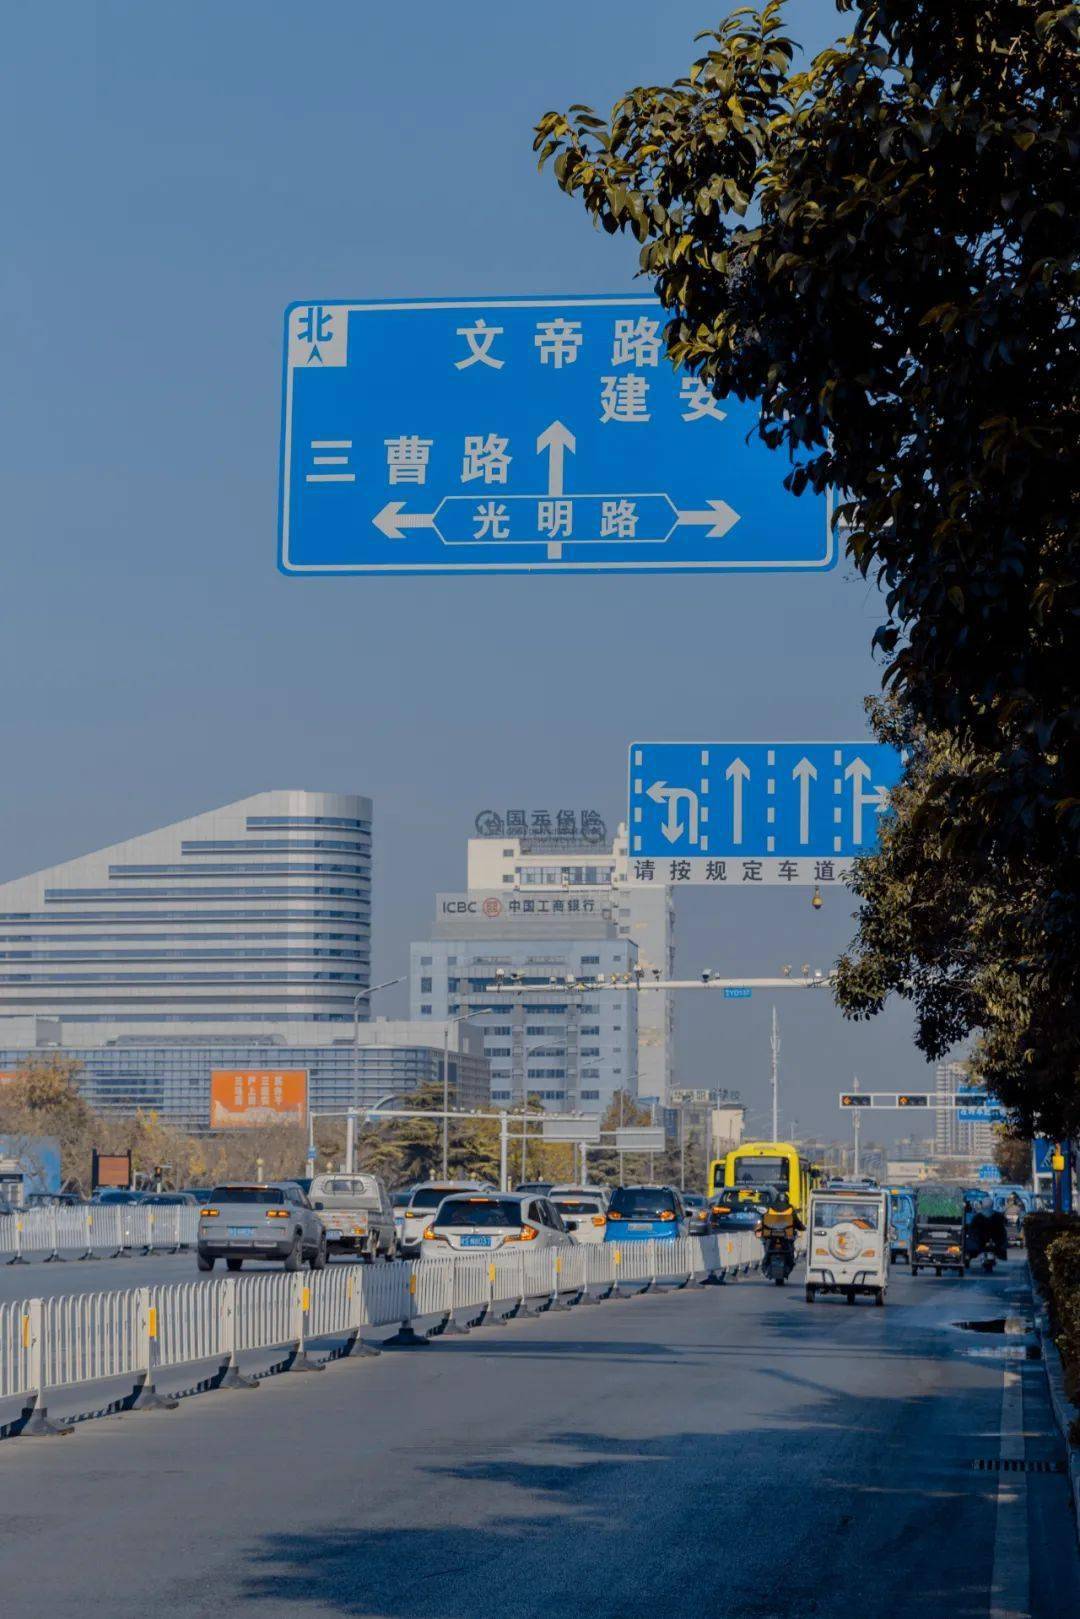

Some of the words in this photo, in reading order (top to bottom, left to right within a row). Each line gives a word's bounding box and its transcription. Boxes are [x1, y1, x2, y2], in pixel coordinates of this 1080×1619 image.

[297, 304, 334, 342] 北
[455, 317, 662, 370] 文帝路
[306, 434, 512, 485] 三曹路
[472, 500, 640, 541] 光明路
[442, 901, 477, 914] ICBC
[508, 898, 596, 914] 中国工商银行
